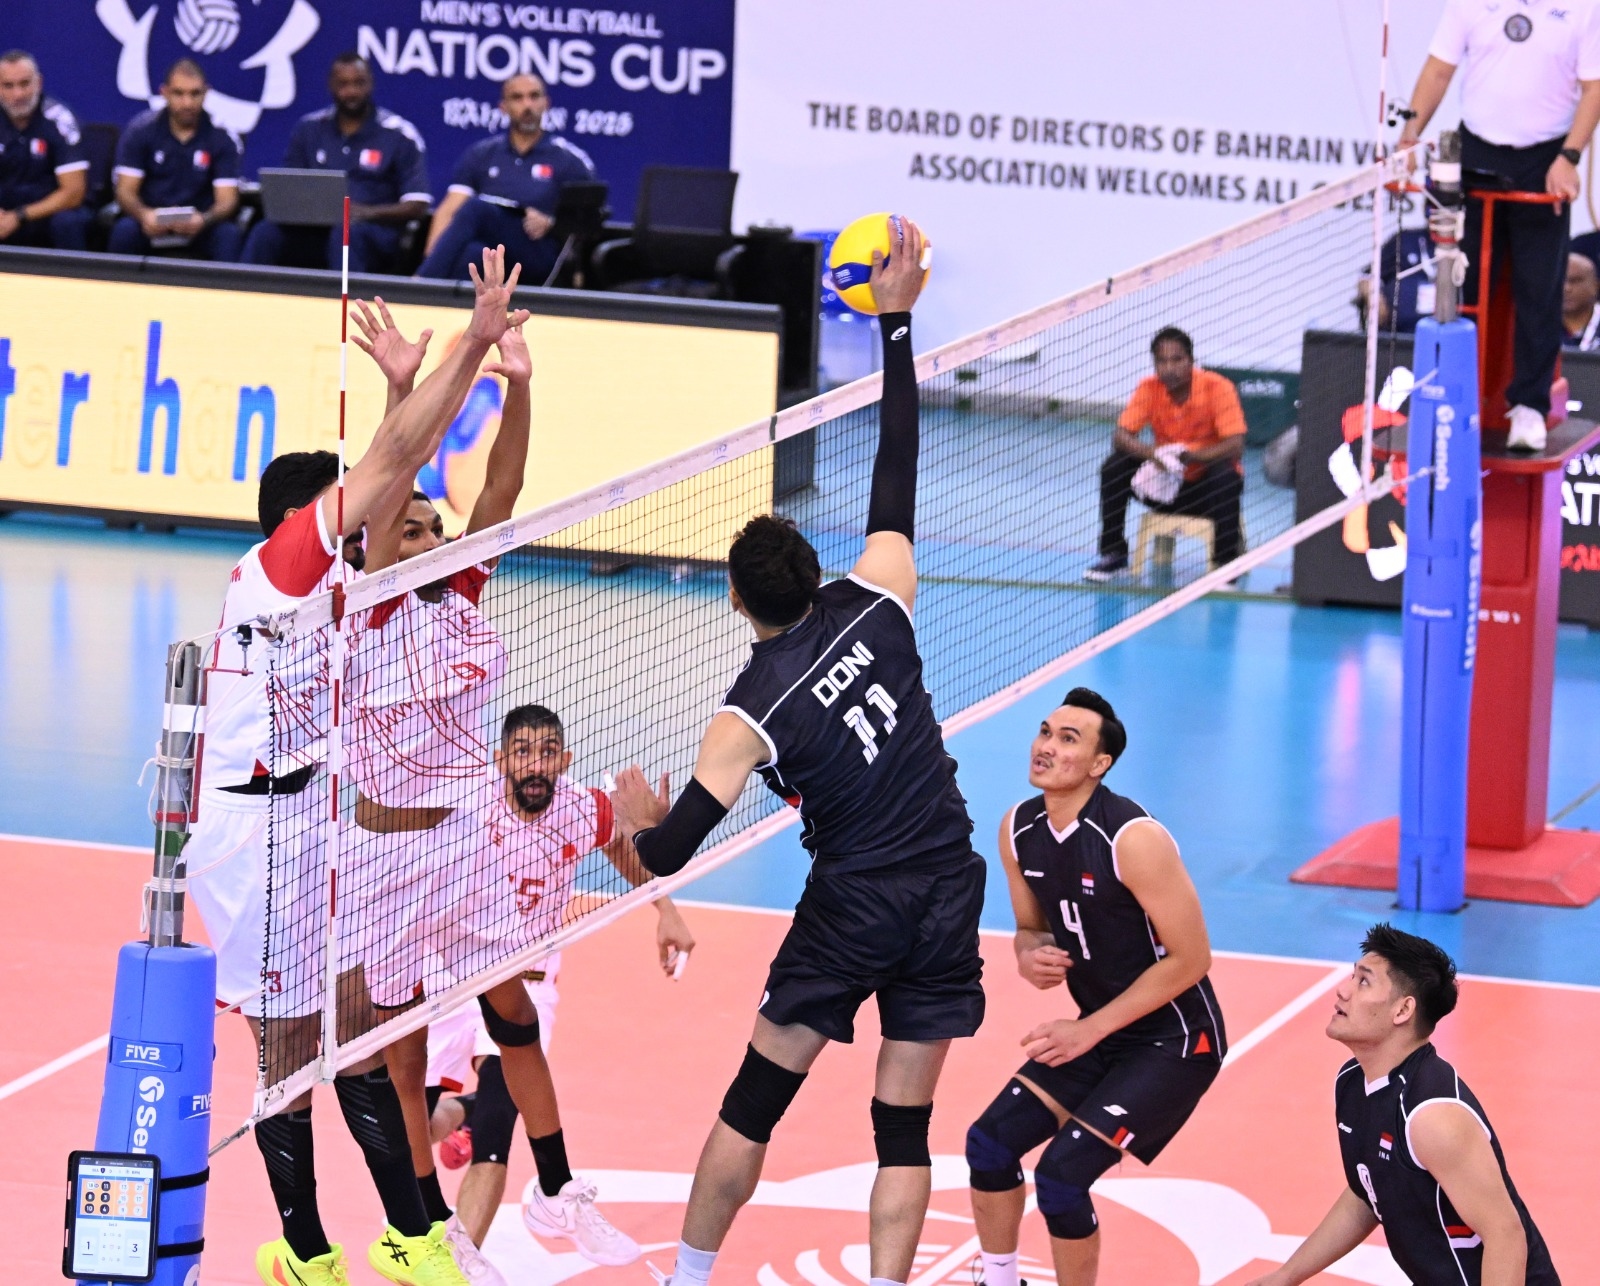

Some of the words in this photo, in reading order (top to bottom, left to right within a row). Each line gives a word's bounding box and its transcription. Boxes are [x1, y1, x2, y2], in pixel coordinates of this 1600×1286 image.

[421, 0, 500, 27] MEN'S
[504, 5, 663, 38] VOLLEYBALL
[357, 25, 596, 87] NATIONS
[611, 43, 726, 94] CUP
[808, 102, 859, 131] THE
[867, 106, 961, 137] BOARD
[969, 113, 1001, 141] OF
[1012, 117, 1163, 151] DIRECTORS
[1173, 127, 1205, 155] OF
[1216, 132, 1343, 164] BAHRAIN
[909, 152, 1086, 190] ASSOCIATION
[1097, 166, 1246, 201] WELCOMES
[1254, 177, 1300, 204] ALL
[1560, 480, 1600, 527] AT
[811, 640, 875, 708] DONI
[842, 683, 898, 765] 11
[1060, 899, 1091, 960] 4
[126, 1044, 161, 1061] FIVB
[1378, 1150, 1390, 1161] INA
